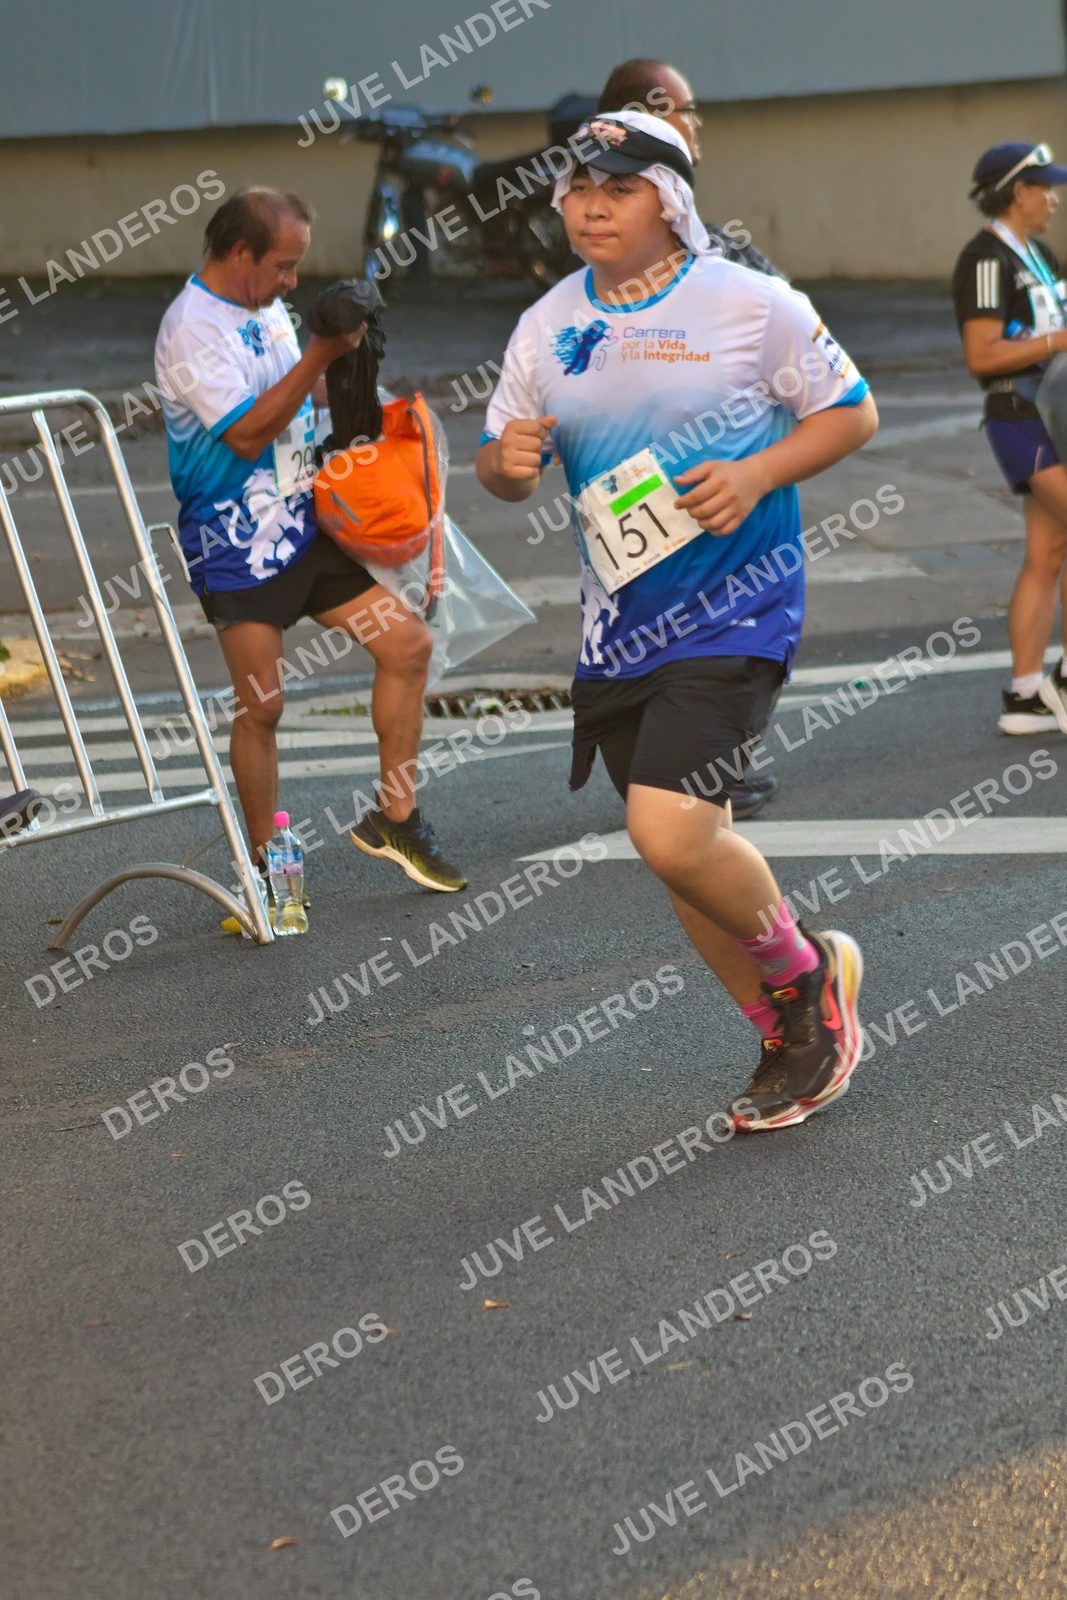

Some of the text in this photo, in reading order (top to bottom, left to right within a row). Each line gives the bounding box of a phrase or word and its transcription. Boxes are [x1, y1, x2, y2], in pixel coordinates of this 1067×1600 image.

[623, 326, 686, 339] Carrera
[621, 341, 640, 353] por
[657, 339, 686, 350] Vida
[643, 352, 710, 363] Integridad
[595, 502, 670, 571] 151
